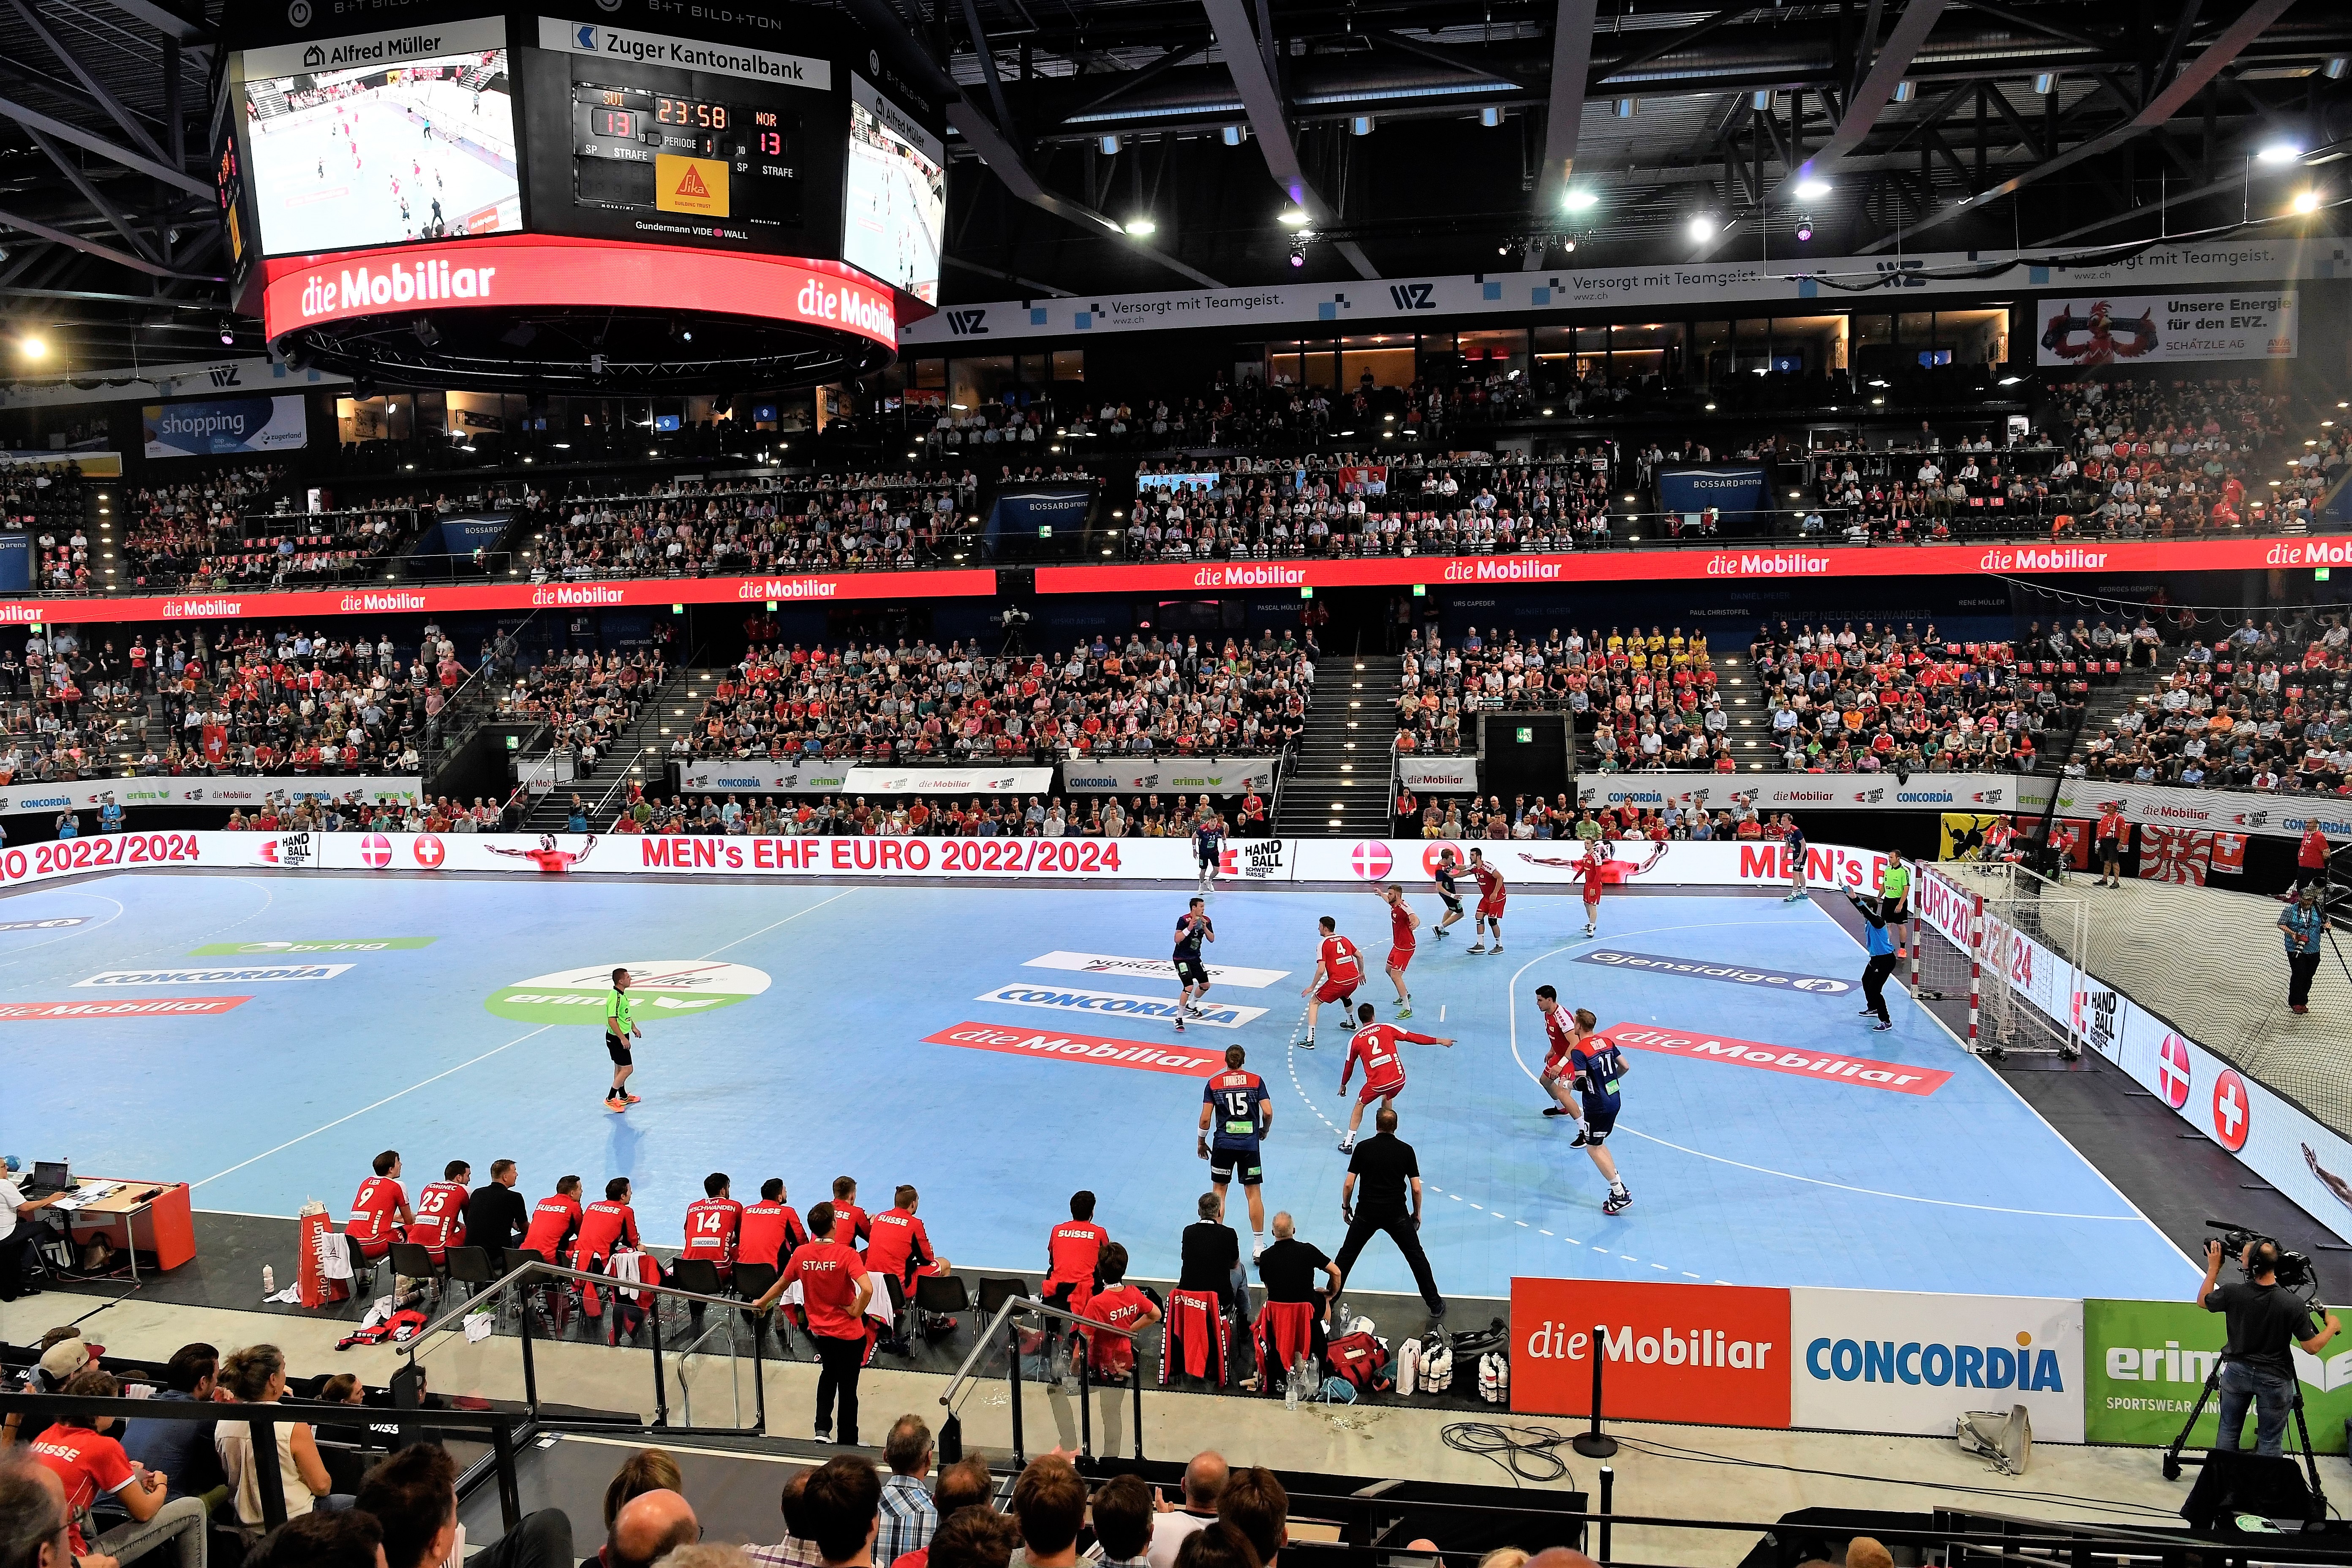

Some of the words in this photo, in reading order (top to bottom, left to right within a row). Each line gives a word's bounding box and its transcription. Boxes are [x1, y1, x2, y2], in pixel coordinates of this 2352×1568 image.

[649, 0, 683, 13] B+T
[691, 6, 781, 30] BILD+TON
[330, 40, 383, 63] Alfred
[388, 35, 441, 57] Müller
[607, 33, 665, 60] Zuger
[671, 43, 803, 80] Kantonalbank
[658, 99, 726, 129] 23:58
[756, 111, 777, 127] NOR
[608, 112, 630, 136] 13
[886, 108, 905, 133] Alfred
[906, 123, 924, 148] Müller
[637, 133, 646, 143] 10
[664, 136, 697, 149] PERIODE
[761, 132, 780, 155] 13
[585, 144, 598, 155] SP
[613, 147, 648, 161] STRAFE
[737, 145, 746, 155] 10
[737, 162, 748, 172] SP
[762, 165, 793, 178] STRAFE
[635, 221, 690, 234] Gundermann
[2149, 254, 2177, 264] mit
[2182, 248, 2276, 266] Teamgeist.
[1573, 275, 1639, 291] Versorgt
[1644, 273, 1670, 286] mit
[2074, 270, 2111, 279] wwz.ch
[302, 276, 336, 317] die
[341, 260, 496, 309] Mobiliar
[1573, 292, 1609, 301] wwz.ch
[798, 278, 837, 320] die
[1112, 300, 1172, 315] Versorgt
[1177, 297, 1200, 310] mit
[1204, 294, 1284, 310] Teamgeist.
[2167, 300, 2224, 313] Unsere
[2230, 297, 2292, 312] Energie
[1113, 316, 1144, 324] wwz.ch
[2167, 318, 2191, 330] für
[2195, 318, 2224, 329] den
[2230, 316, 2267, 328] EVZ.
[2166, 338, 2225, 350] SCHÄTZLE
[2229, 340, 2245, 348] AG
[162, 410, 245, 437] shopping
[271, 432, 302, 441] zugerland
[1980, 550, 2013, 570] die
[2015, 548, 2108, 569] Mobiliar
[2266, 542, 2302, 565] die
[1444, 561, 1474, 580] die
[1476, 559, 1563, 579] Mobiliar
[1707, 555, 1738, 574] die
[1740, 553, 1830, 573] Mobiliar
[1194, 567, 1222, 586] die
[1225, 565, 1306, 585] Mobiliar
[532, 588, 555, 605] die
[557, 586, 624, 604] Mobiliar
[738, 581, 763, 599] die
[765, 579, 837, 598] Mobiliar
[163, 601, 182, 617] die
[184, 599, 242, 616] Mobiliar
[340, 594, 362, 611] die
[364, 593, 426, 610] Mobiliar
[718, 776, 761, 787] CONCORDIA
[810, 777, 839, 786] erima
[919, 780, 933, 788] die
[1070, 775, 1118, 787] CONCORDIA
[1173, 777, 1204, 786] erima
[1408, 775, 1422, 784] die
[1423, 775, 1464, 784] Mobiliar
[20, 795, 72, 808] CONCORDIA
[126, 791, 156, 800] erima
[212, 791, 223, 799] die
[223, 790, 252, 799] Mobiliar
[374, 791, 400, 799] erima
[1773, 791, 1788, 801] die
[1790, 791, 1834, 800] Mobiliar
[1896, 789, 1953, 803] CONCORDIA
[2142, 805, 2159, 816] die
[2161, 806, 2210, 820] Mobiliar
[283, 832, 310, 847] HAND
[35, 835, 199, 874] 2022/2024
[288, 845, 311, 856] BALL
[642, 838, 743, 868] MEN's
[754, 839, 820, 869] EHF
[830, 840, 930, 871] EURO
[941, 840, 1122, 872] 2022/2024
[1245, 839, 1282, 857] HAND
[1252, 854, 1283, 867] BALL
[286, 939, 390, 951] bring
[1337, 941, 1346, 956] 4
[92, 964, 332, 984] CONCORDIA
[1591, 951, 1790, 985] Gjensidige
[38, 1001, 228, 1016] Mobiliar
[2091, 991, 2117, 1014] HAND
[1358, 1026, 1381, 1039] SCHMID
[2095, 1010, 2115, 1040] BALL
[949, 1028, 1020, 1045] die
[1013, 1034, 1214, 1068] Mobiliar
[1368, 1036, 1383, 1055] 2
[1371, 1056, 1391, 1066] CONCORDIA
[1598, 1053, 1614, 1077] 27
[1615, 1031, 1692, 1048] die
[1690, 1040, 1923, 1086] Mobiliar
[1225, 1092, 1247, 1116] 15
[1236, 1122, 1254, 1133] bring
[427, 1182, 457, 1191] TOMINEC
[358, 1187, 374, 1208] 9
[422, 1191, 449, 1212] 25
[536, 1202, 568, 1214] SUISSE
[589, 1203, 621, 1214] SUISSE
[746, 1206, 782, 1216] SUISSE
[696, 1211, 721, 1233] 14
[877, 1213, 909, 1227] SUISSE
[692, 1237, 719, 1247] CONCORDIA
[1057, 1229, 1095, 1241] SUISSE
[312, 1220, 325, 1274] Mobiliar
[802, 1260, 837, 1271] STAFF
[1110, 1303, 1138, 1322] STAFF
[1527, 1320, 1588, 1360] die
[1597, 1324, 1772, 1369] Mobiliar
[1806, 1331, 2065, 1393] CONCORDIA
[2106, 1396, 2192, 1413] SPORTSWEAR
